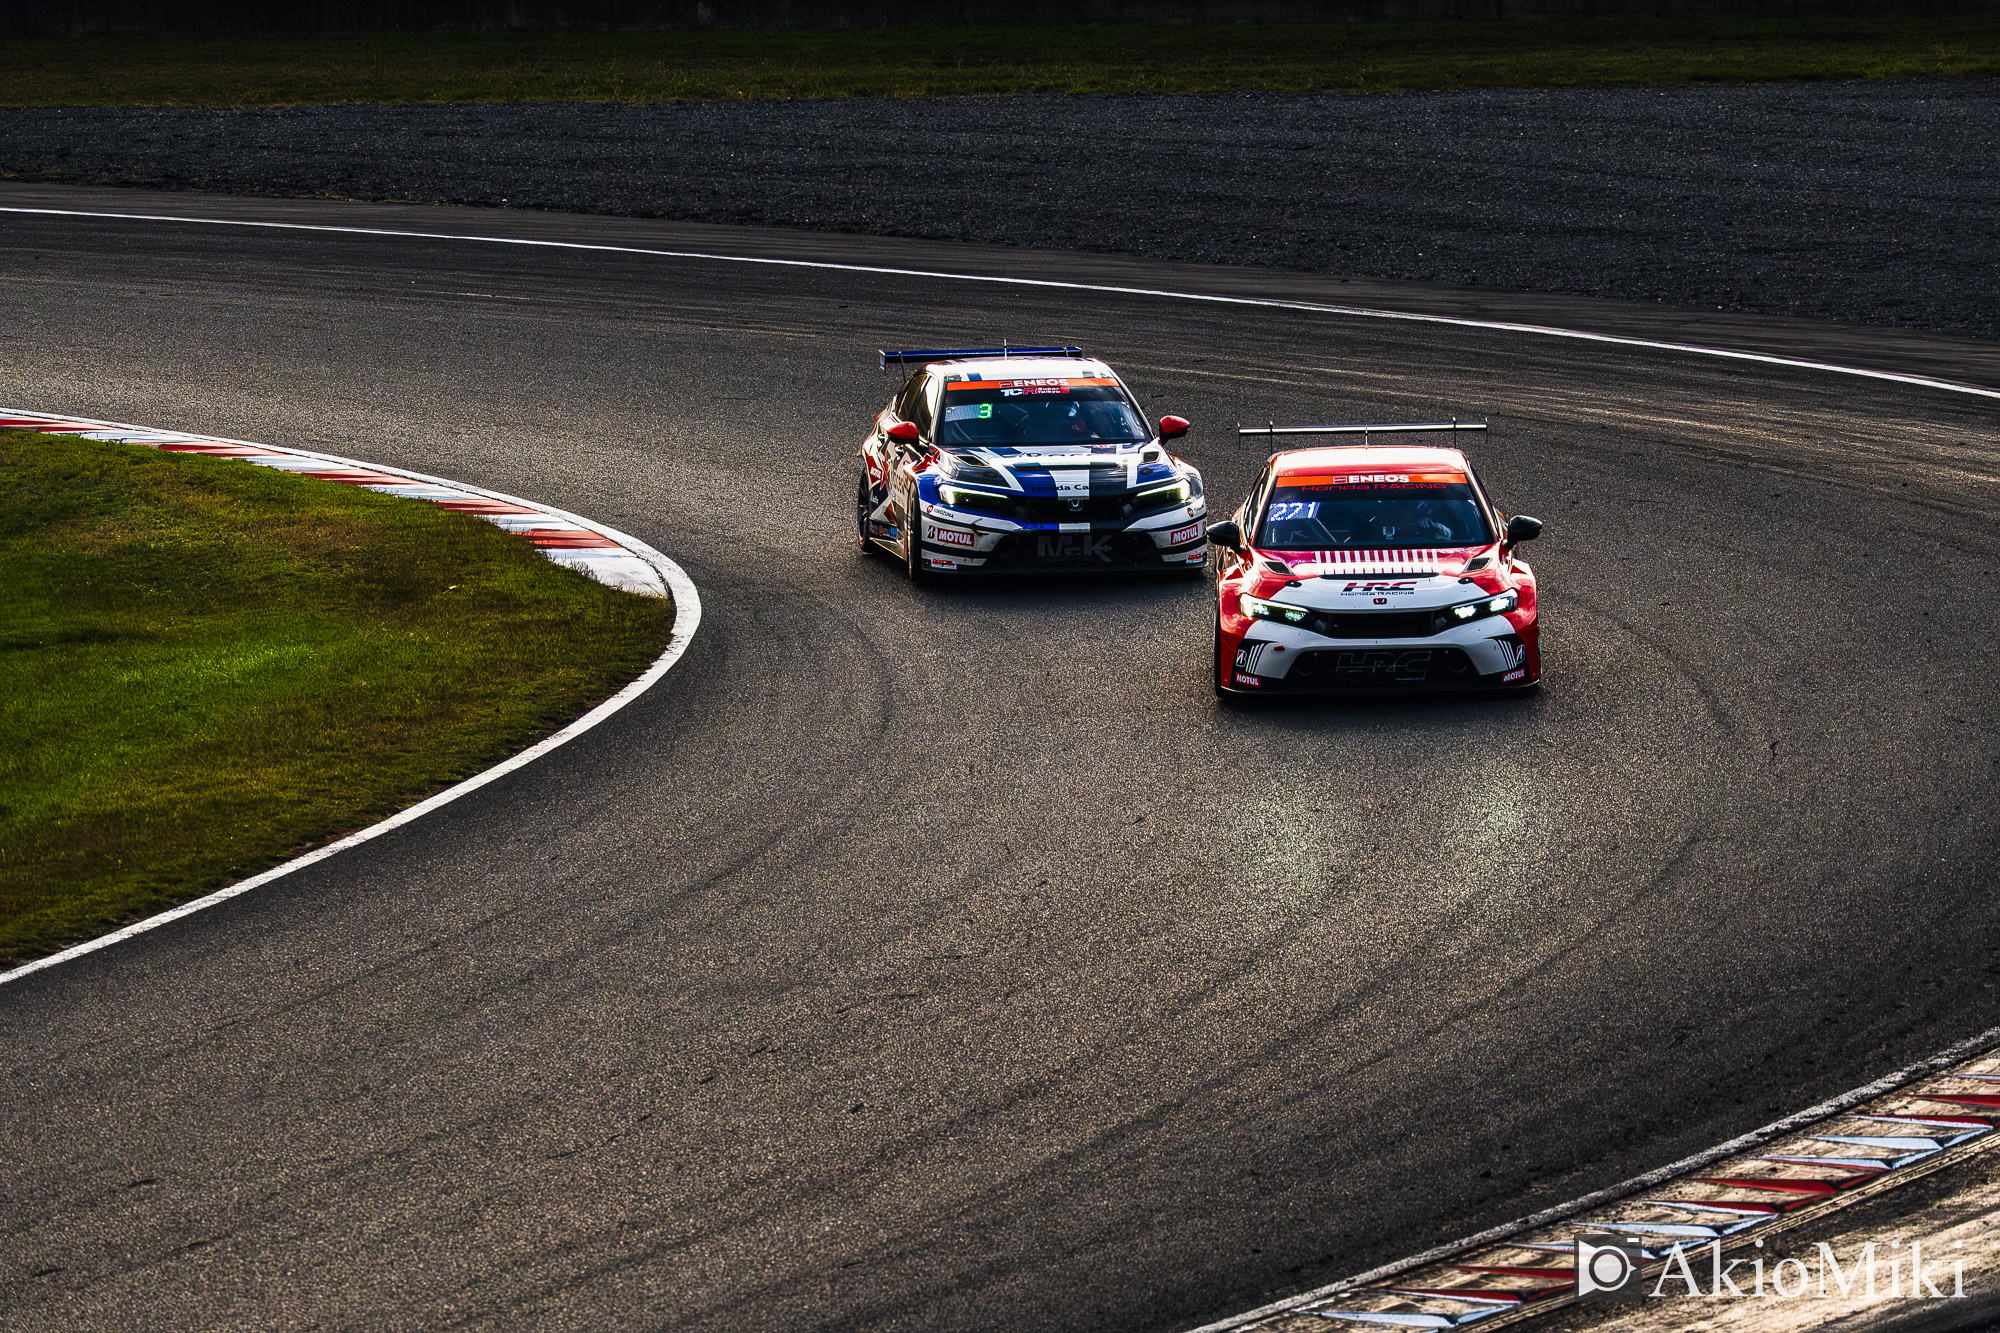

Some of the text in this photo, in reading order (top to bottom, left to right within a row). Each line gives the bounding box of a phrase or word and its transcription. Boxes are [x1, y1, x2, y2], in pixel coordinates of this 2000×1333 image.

[1013, 379, 1069, 387] ENEOS
[978, 403, 992, 419] 3
[1349, 474, 1410, 483] ENEOS
[938, 530, 973, 545] MOTUL
[1172, 526, 1198, 544] MOTUL
[1342, 581, 1418, 592] HRC
[1236, 674, 1259, 686] MOTUL
[1503, 669, 1525, 682] MOTUL
